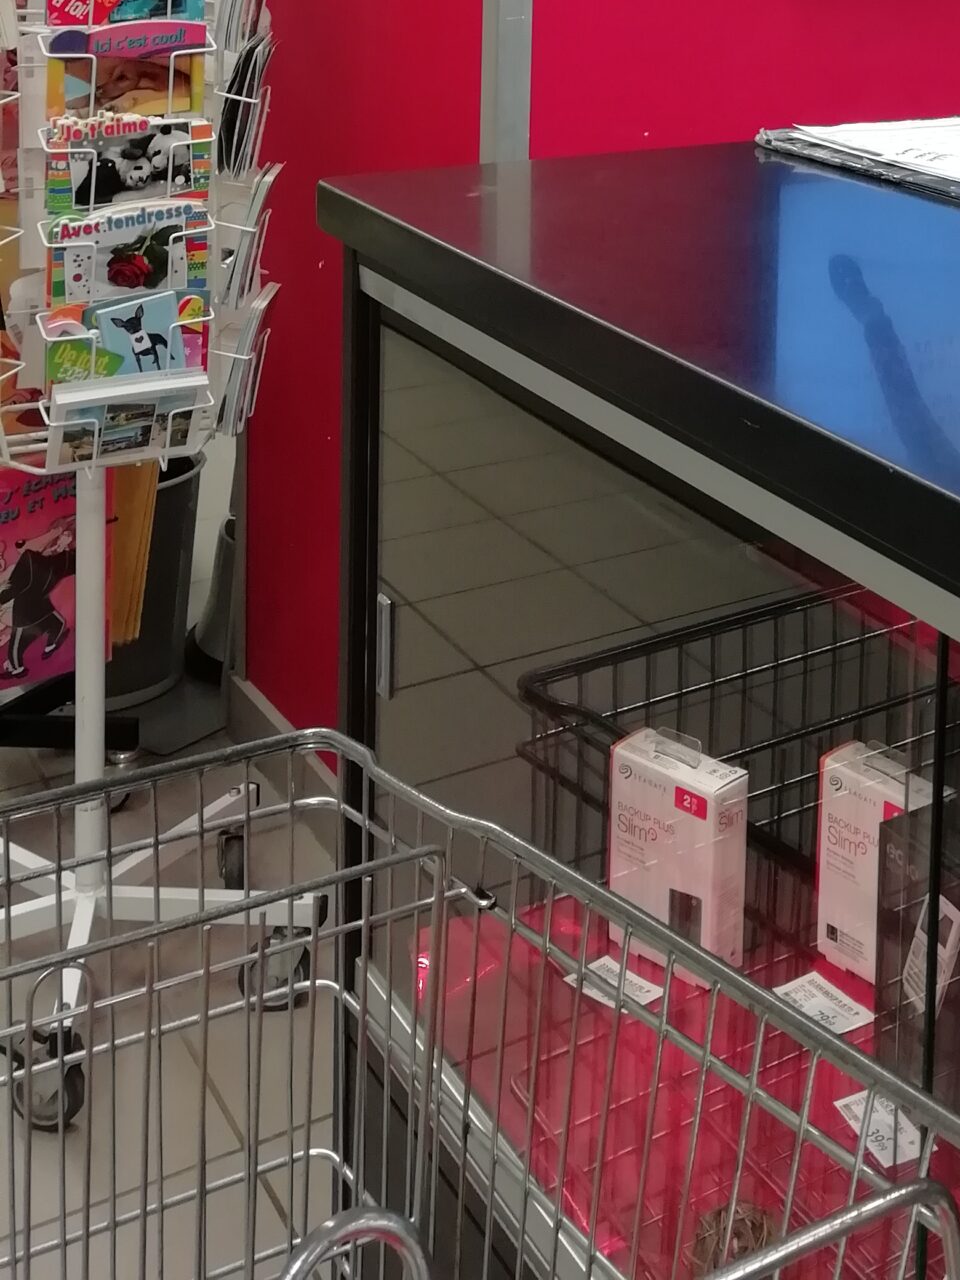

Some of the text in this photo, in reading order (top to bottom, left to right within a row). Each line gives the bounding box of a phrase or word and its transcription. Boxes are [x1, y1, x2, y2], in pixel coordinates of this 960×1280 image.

[60, 203, 194, 242] Avec tendresse
[633, 773, 667, 793] SEAGATE
[617, 801, 675, 835] BACKUP PLUS
[617, 813, 648, 842] Slim
[828, 812, 879, 848] BACKUP PLU
[827, 825, 858, 856] Slim
